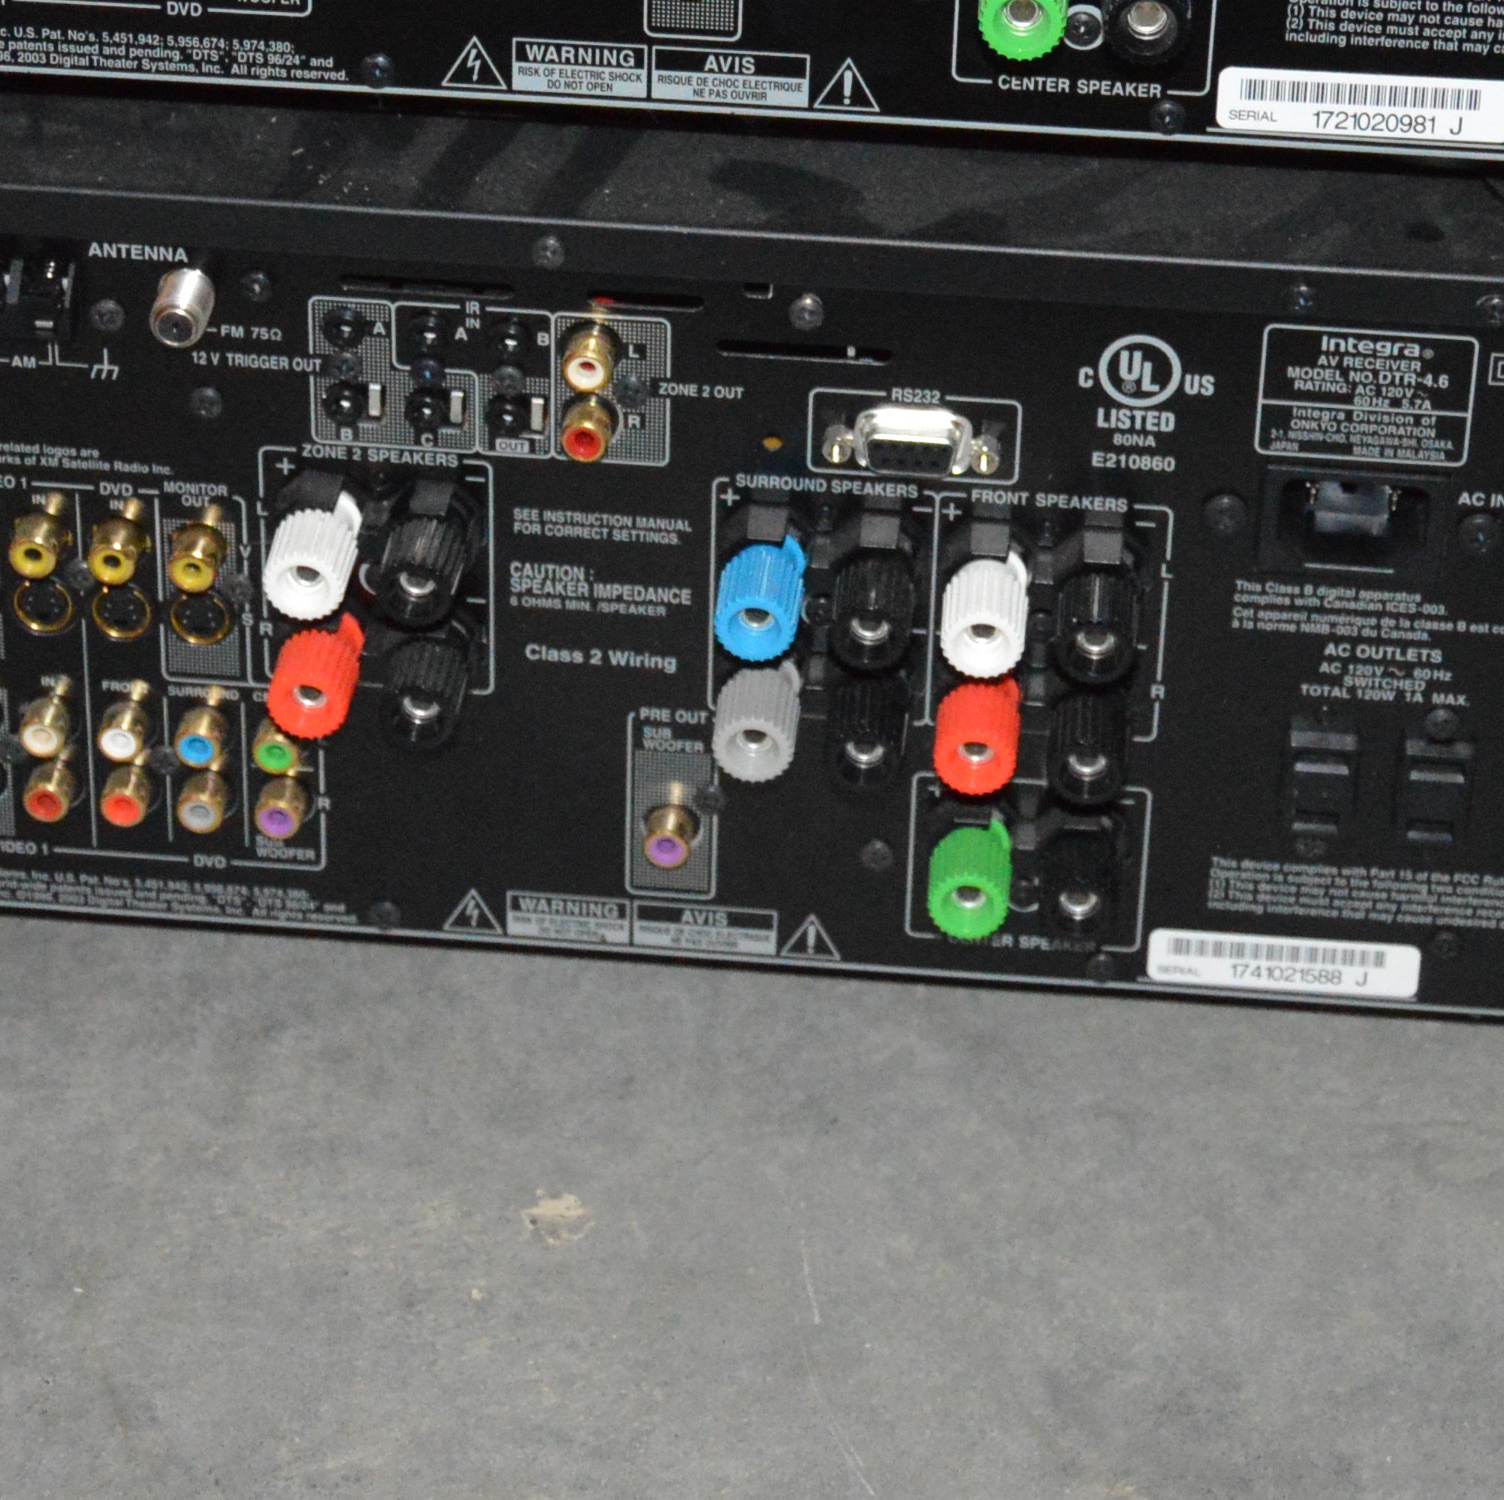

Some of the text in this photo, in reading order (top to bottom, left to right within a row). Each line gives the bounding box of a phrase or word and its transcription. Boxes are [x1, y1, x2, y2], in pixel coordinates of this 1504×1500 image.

[525, 43, 634, 68] WARNING
[703, 54, 755, 75] AVIS
[997, 73, 1161, 98] CENTER SPEAKER
[1228, 108, 1277, 122] SERIAL
[1312, 109, 1463, 135] 1721020981 J
[87, 241, 188, 263] ANTENNA
[1321, 336, 1420, 357] Integra
[891, 387, 940, 404] RS232
[1185, 373, 1215, 396] US
[1096, 406, 1175, 432] LISTED
[301, 442, 458, 468] ZONE 2 SPEAKERS
[1091, 450, 1176, 472] E210860
[735, 472, 918, 498] SURROUND SPEAKERS
[970, 487, 1127, 513] FRONT SPEAKERS
[1457, 491, 1485, 506] AC
[524, 642, 677, 674] Class 2 Wiring
[1323, 642, 1442, 663] AC OUTLETS
